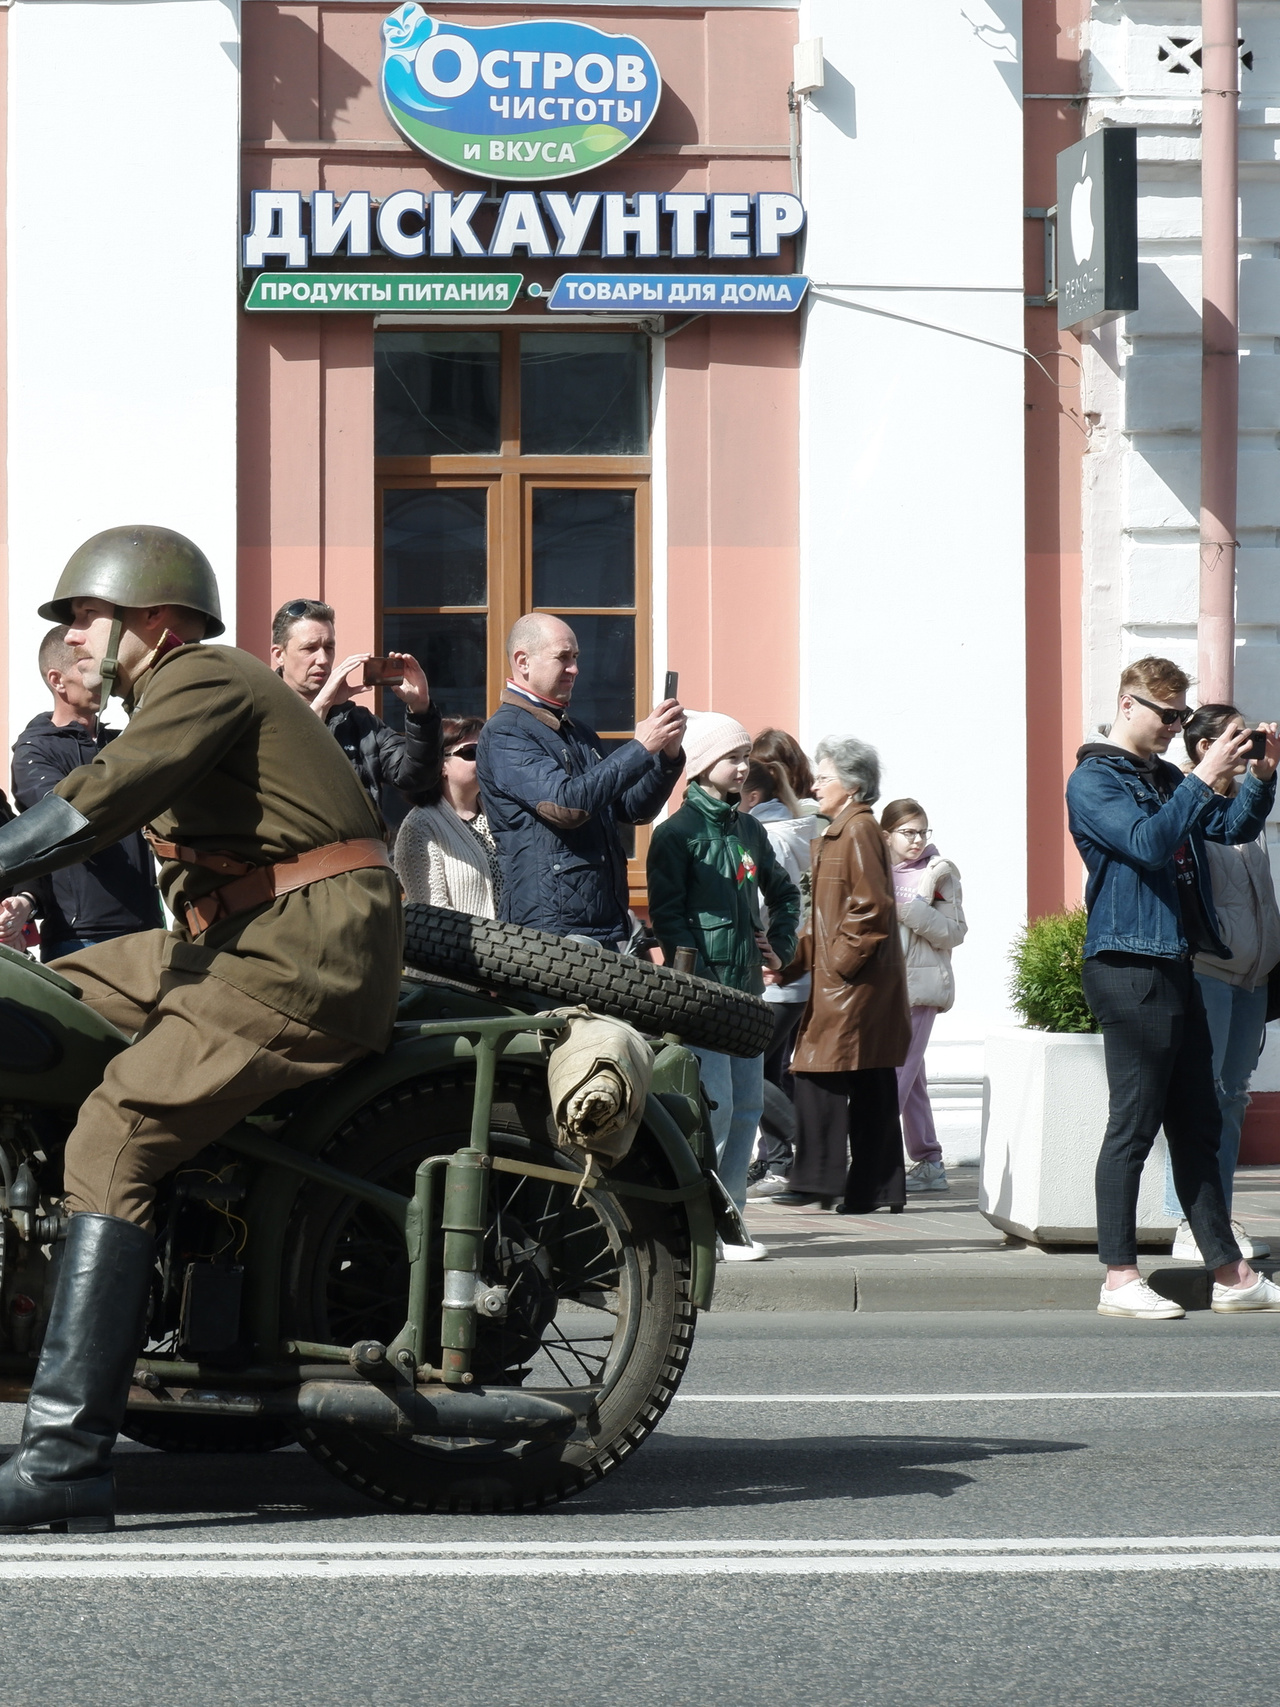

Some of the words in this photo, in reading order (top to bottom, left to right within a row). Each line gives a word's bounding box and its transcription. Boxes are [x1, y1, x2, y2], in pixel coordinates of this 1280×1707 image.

[489, 96, 642, 123] ЧИСТОТЫ
[489, 140, 576, 163] ВКУСА
[243, 190, 807, 268] ДИСКАУНТЕР
[260, 281, 392, 304] ПРОДУКТЫ
[398, 282, 509, 302] ПИТАНИЯ
[565, 281, 662, 302] ТОВАРЫ
[667, 282, 715, 306] ДЛЯ
[720, 282, 792, 306] ДОМА
